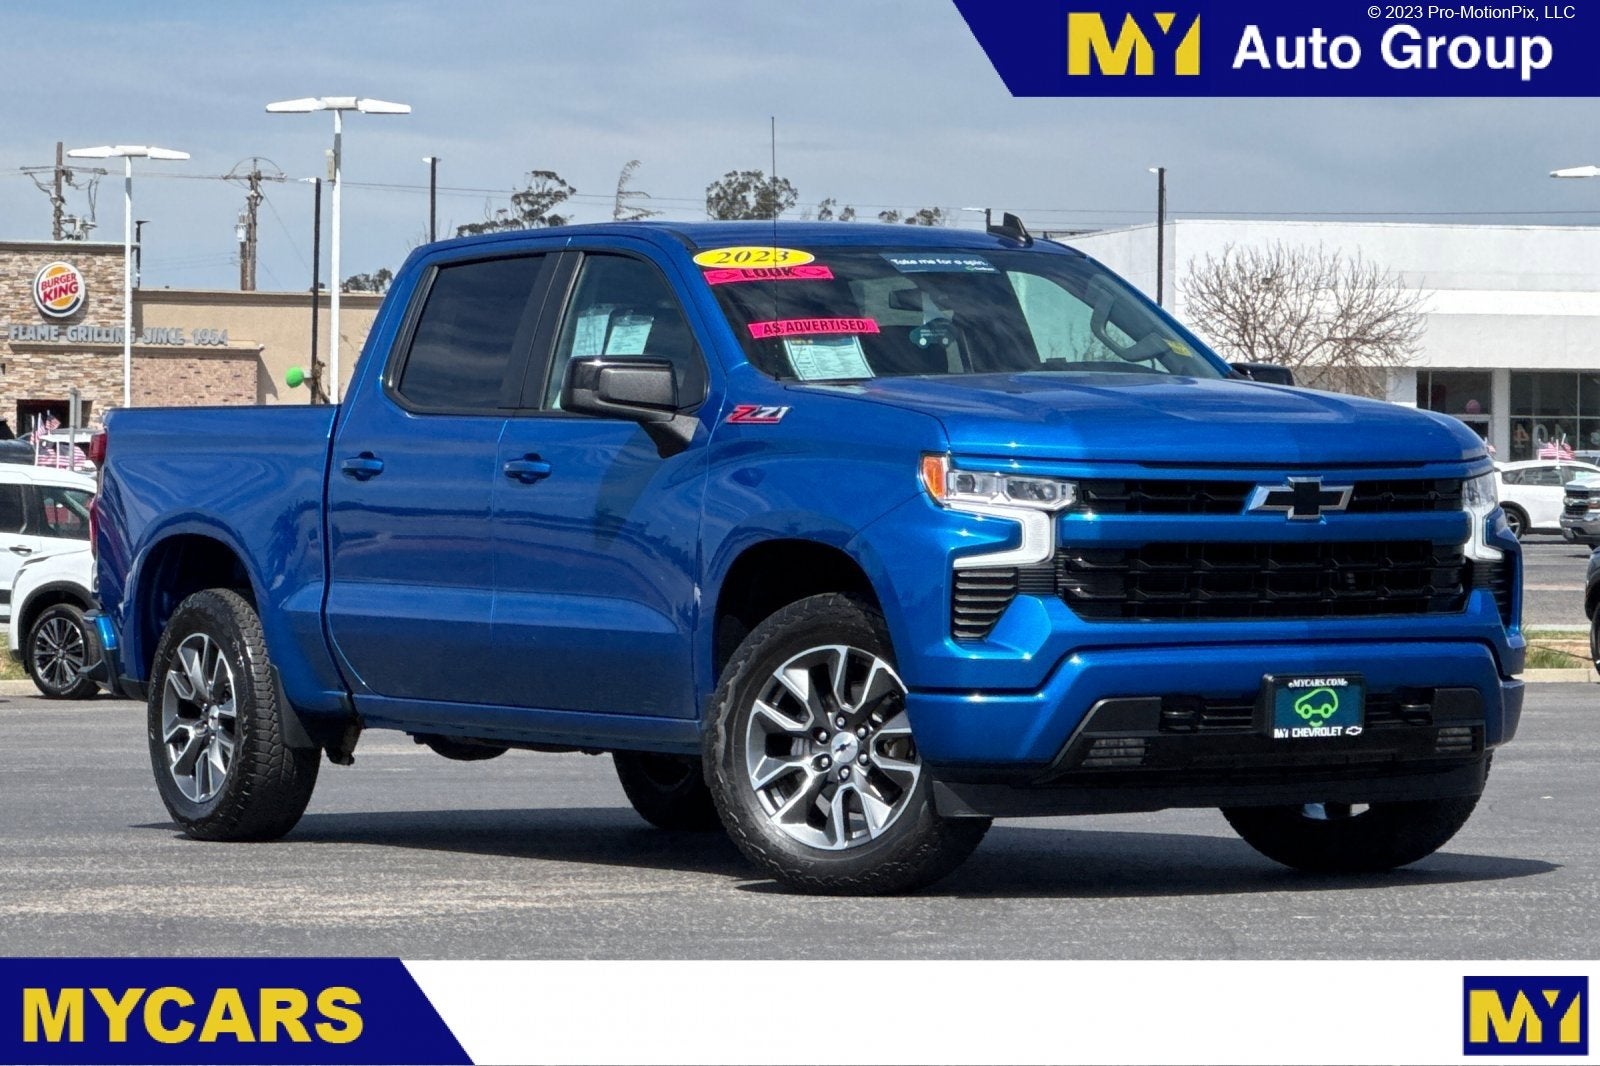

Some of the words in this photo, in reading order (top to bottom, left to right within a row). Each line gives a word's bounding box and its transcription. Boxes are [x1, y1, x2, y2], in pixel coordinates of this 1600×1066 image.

[715, 251, 789, 264] 2023
[890, 258, 917, 266] Take
[741, 267, 797, 279] LOOK
[41, 272, 77, 291] BURGER
[42, 281, 79, 305] KING
[786, 319, 866, 333] ADVERTISED
[9, 325, 59, 341] FLAME
[142, 327, 185, 346] SINCE
[192, 327, 229, 347] 1954
[726, 404, 790, 424] Z71
[1293, 678, 1345, 687] MYCARS.COM
[1274, 728, 1289, 738] MY
[1292, 727, 1342, 737] CHEVROLET
